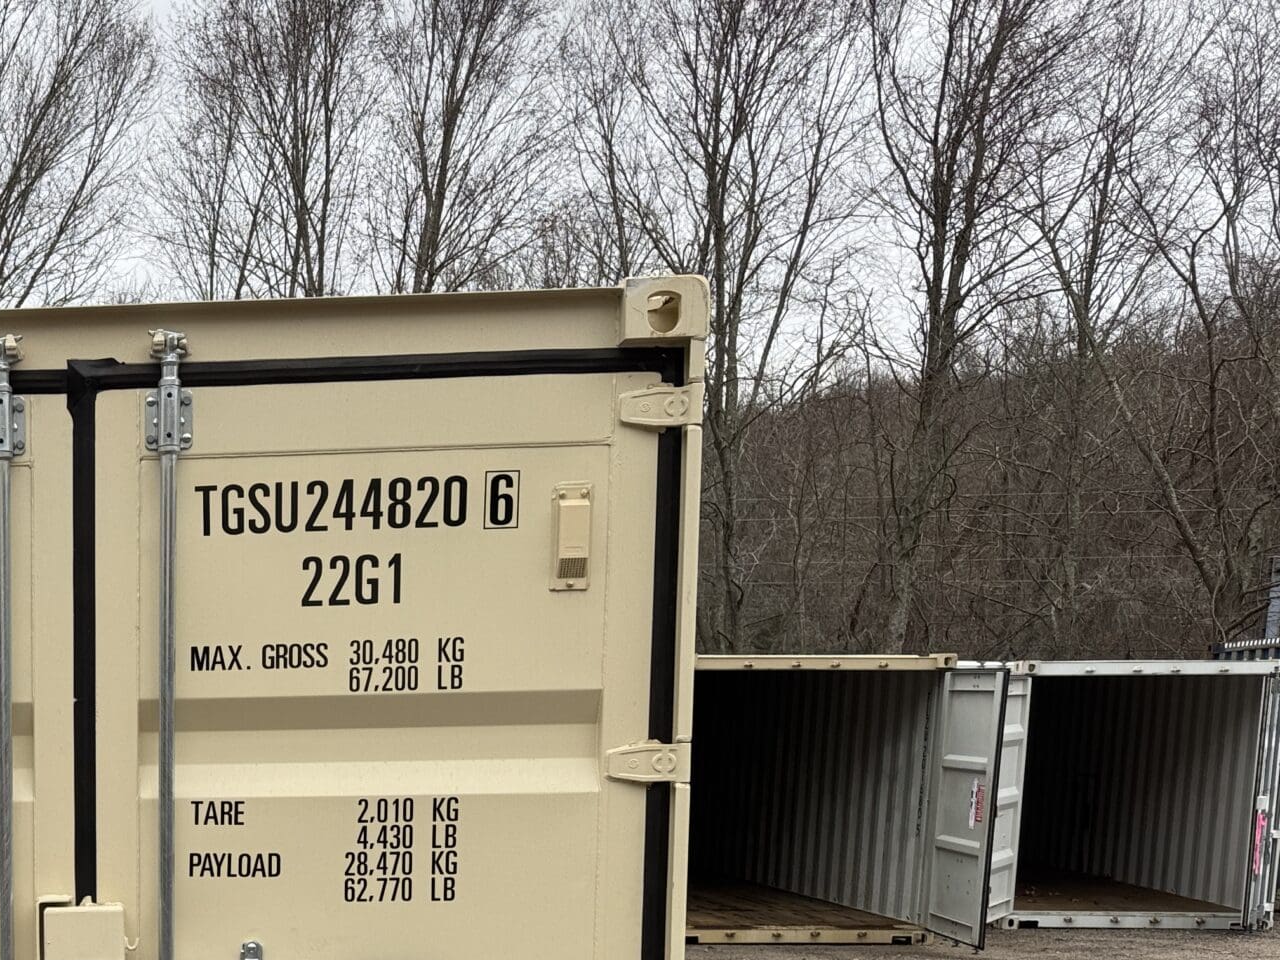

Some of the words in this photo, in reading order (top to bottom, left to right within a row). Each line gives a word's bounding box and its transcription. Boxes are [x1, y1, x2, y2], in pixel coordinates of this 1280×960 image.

[195, 476, 467, 536] TGSU244820
[489, 474, 514, 526] 6
[302, 553, 401, 606] 22G1
[191, 645, 250, 671] MAX.
[262, 643, 328, 669] GROSS
[350, 639, 418, 665] 30,480
[438, 637, 464, 662] KG
[350, 666, 418, 692] 67,200
[438, 665, 462, 689] LB
[191, 801, 244, 825] TARE
[358, 798, 413, 823] 2,010
[433, 797, 458, 822] KG
[357, 825, 413, 849] 4,430
[432, 824, 456, 848] LB
[189, 853, 280, 877] PAYLOAD
[345, 851, 412, 876] 28,470
[432, 851, 457, 875] KG
[345, 877, 412, 902] 62,770
[431, 877, 455, 901] LB
